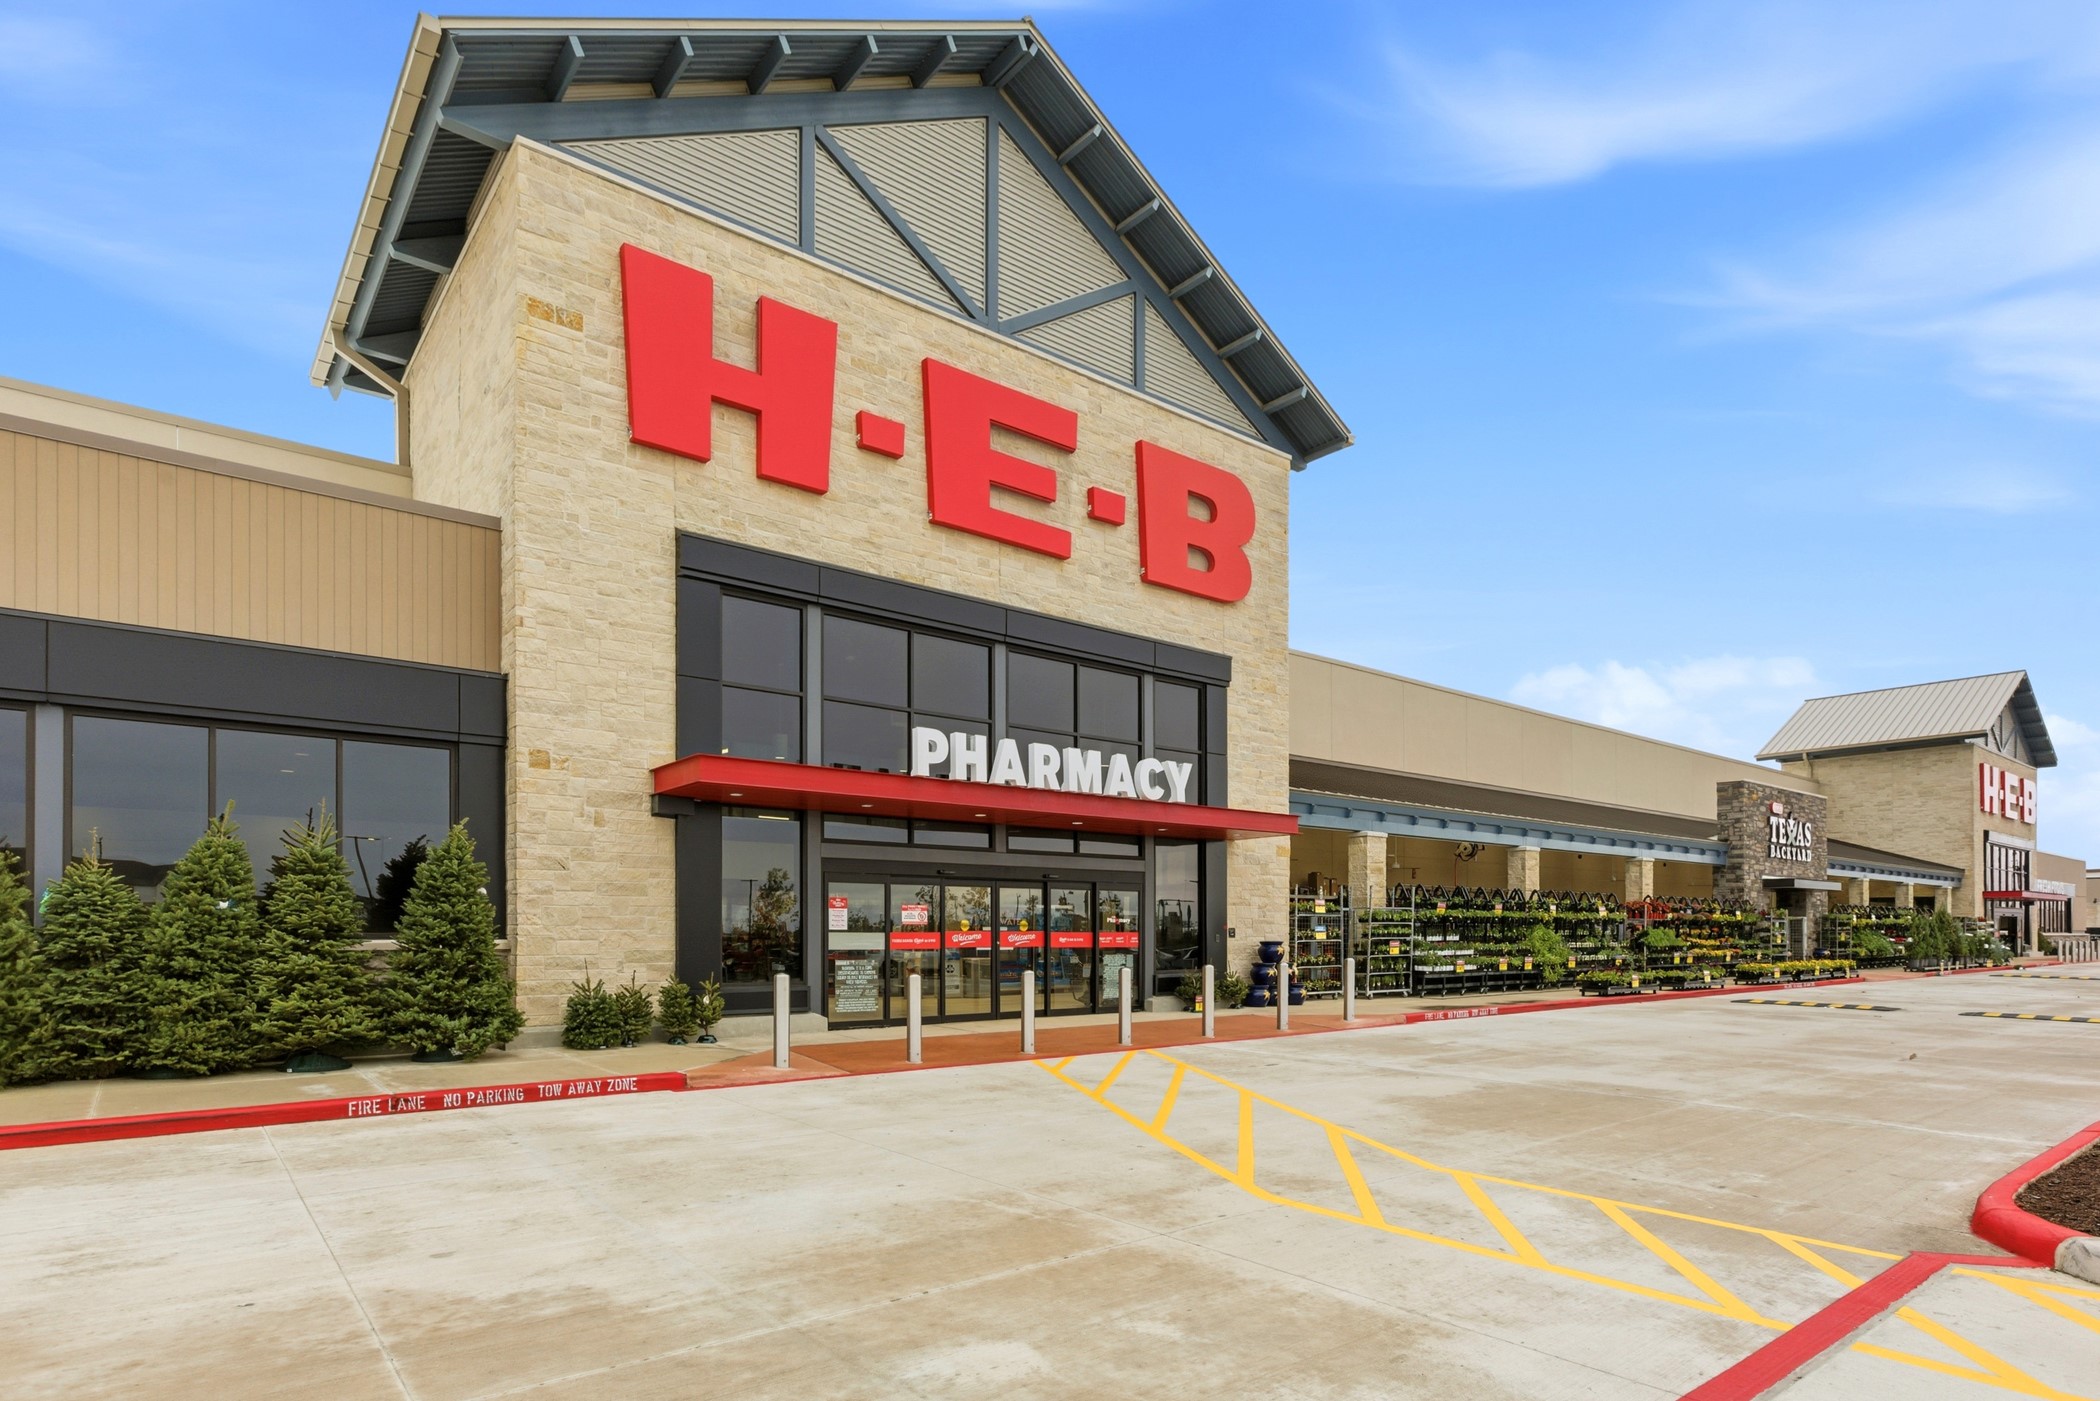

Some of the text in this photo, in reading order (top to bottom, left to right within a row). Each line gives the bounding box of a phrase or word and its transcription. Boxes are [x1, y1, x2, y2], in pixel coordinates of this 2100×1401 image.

[620, 243, 1256, 603] H-E-B
[911, 727, 1193, 803] PHARMACY
[1979, 763, 2036, 824] H-E-B
[1768, 813, 1811, 847] TEXAS
[1769, 845, 1812, 862] BACKYARD
[952, 933, 982, 943] Welcome
[1000, 918, 1021, 926] WATE
[1008, 933, 1036, 943] Welcome
[348, 1077, 638, 1116] FIRE LANE NO PARKING TOW AWAY ZONE
